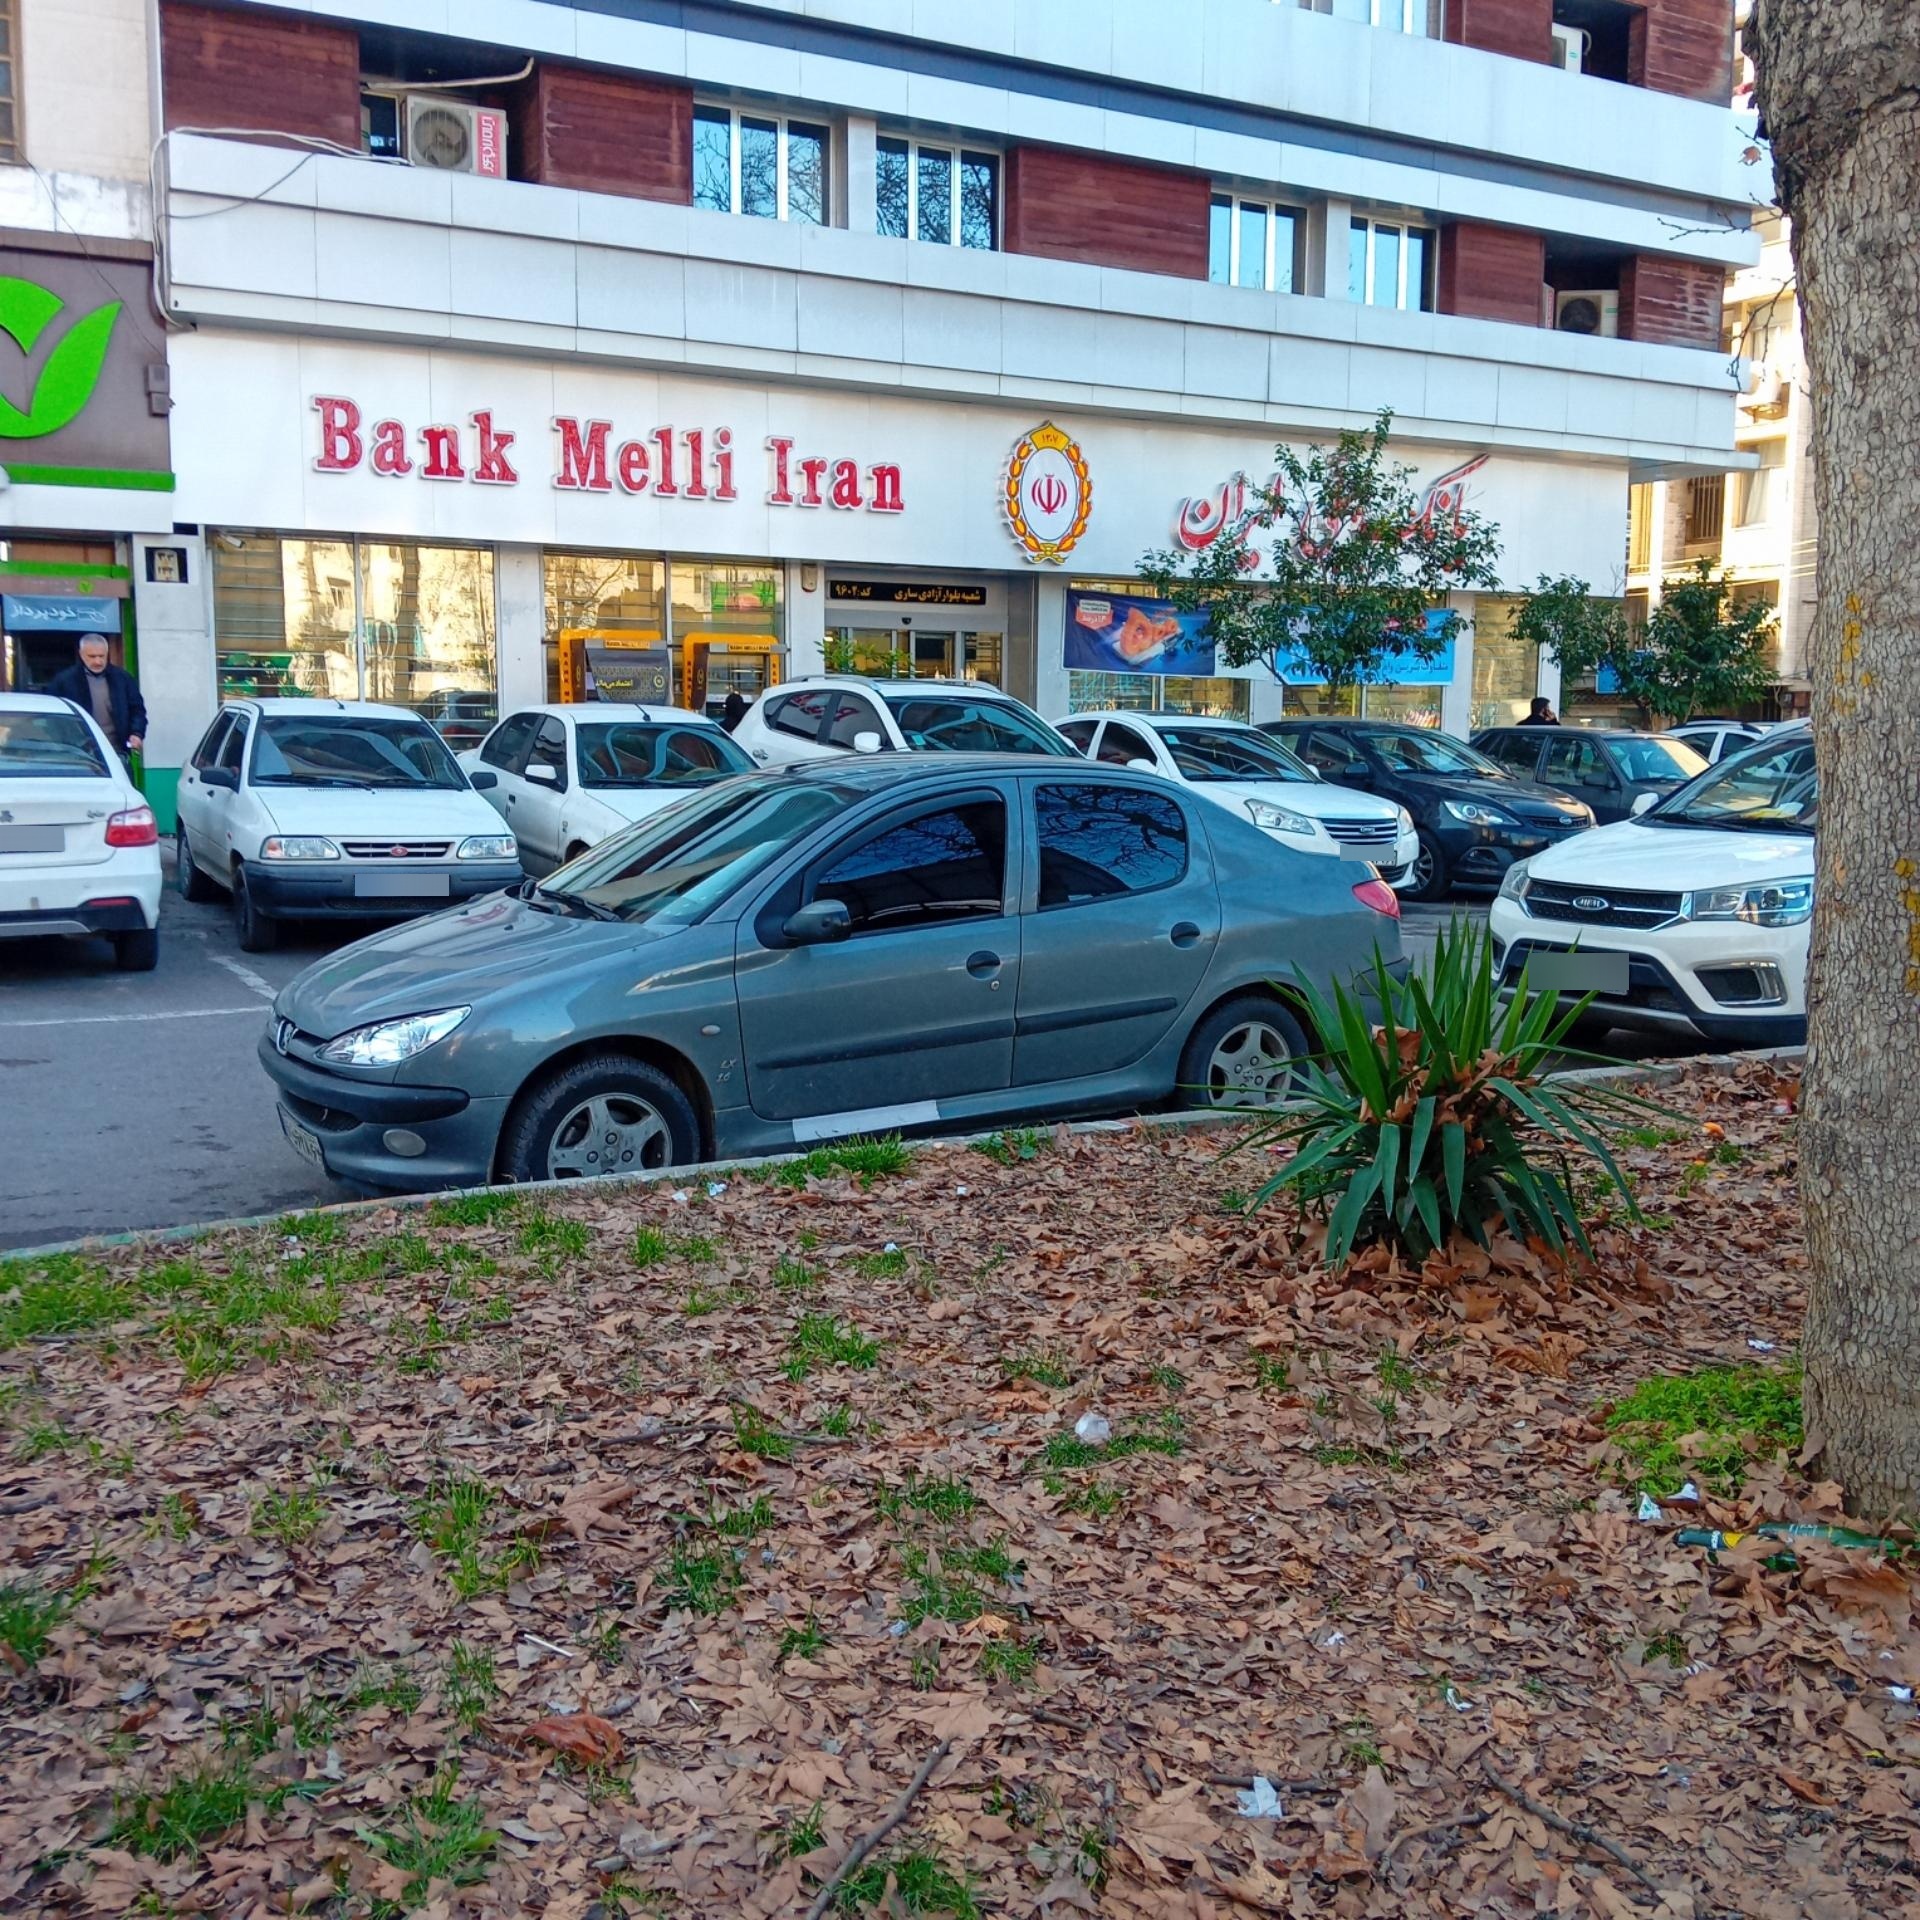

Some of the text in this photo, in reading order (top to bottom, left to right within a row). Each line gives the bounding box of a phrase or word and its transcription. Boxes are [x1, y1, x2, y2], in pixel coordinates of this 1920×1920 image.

[311, 394, 905, 512] Bank Melli Iran
[894, 587, 918, 601] ساری
[918, 586, 943, 602] آزادی
